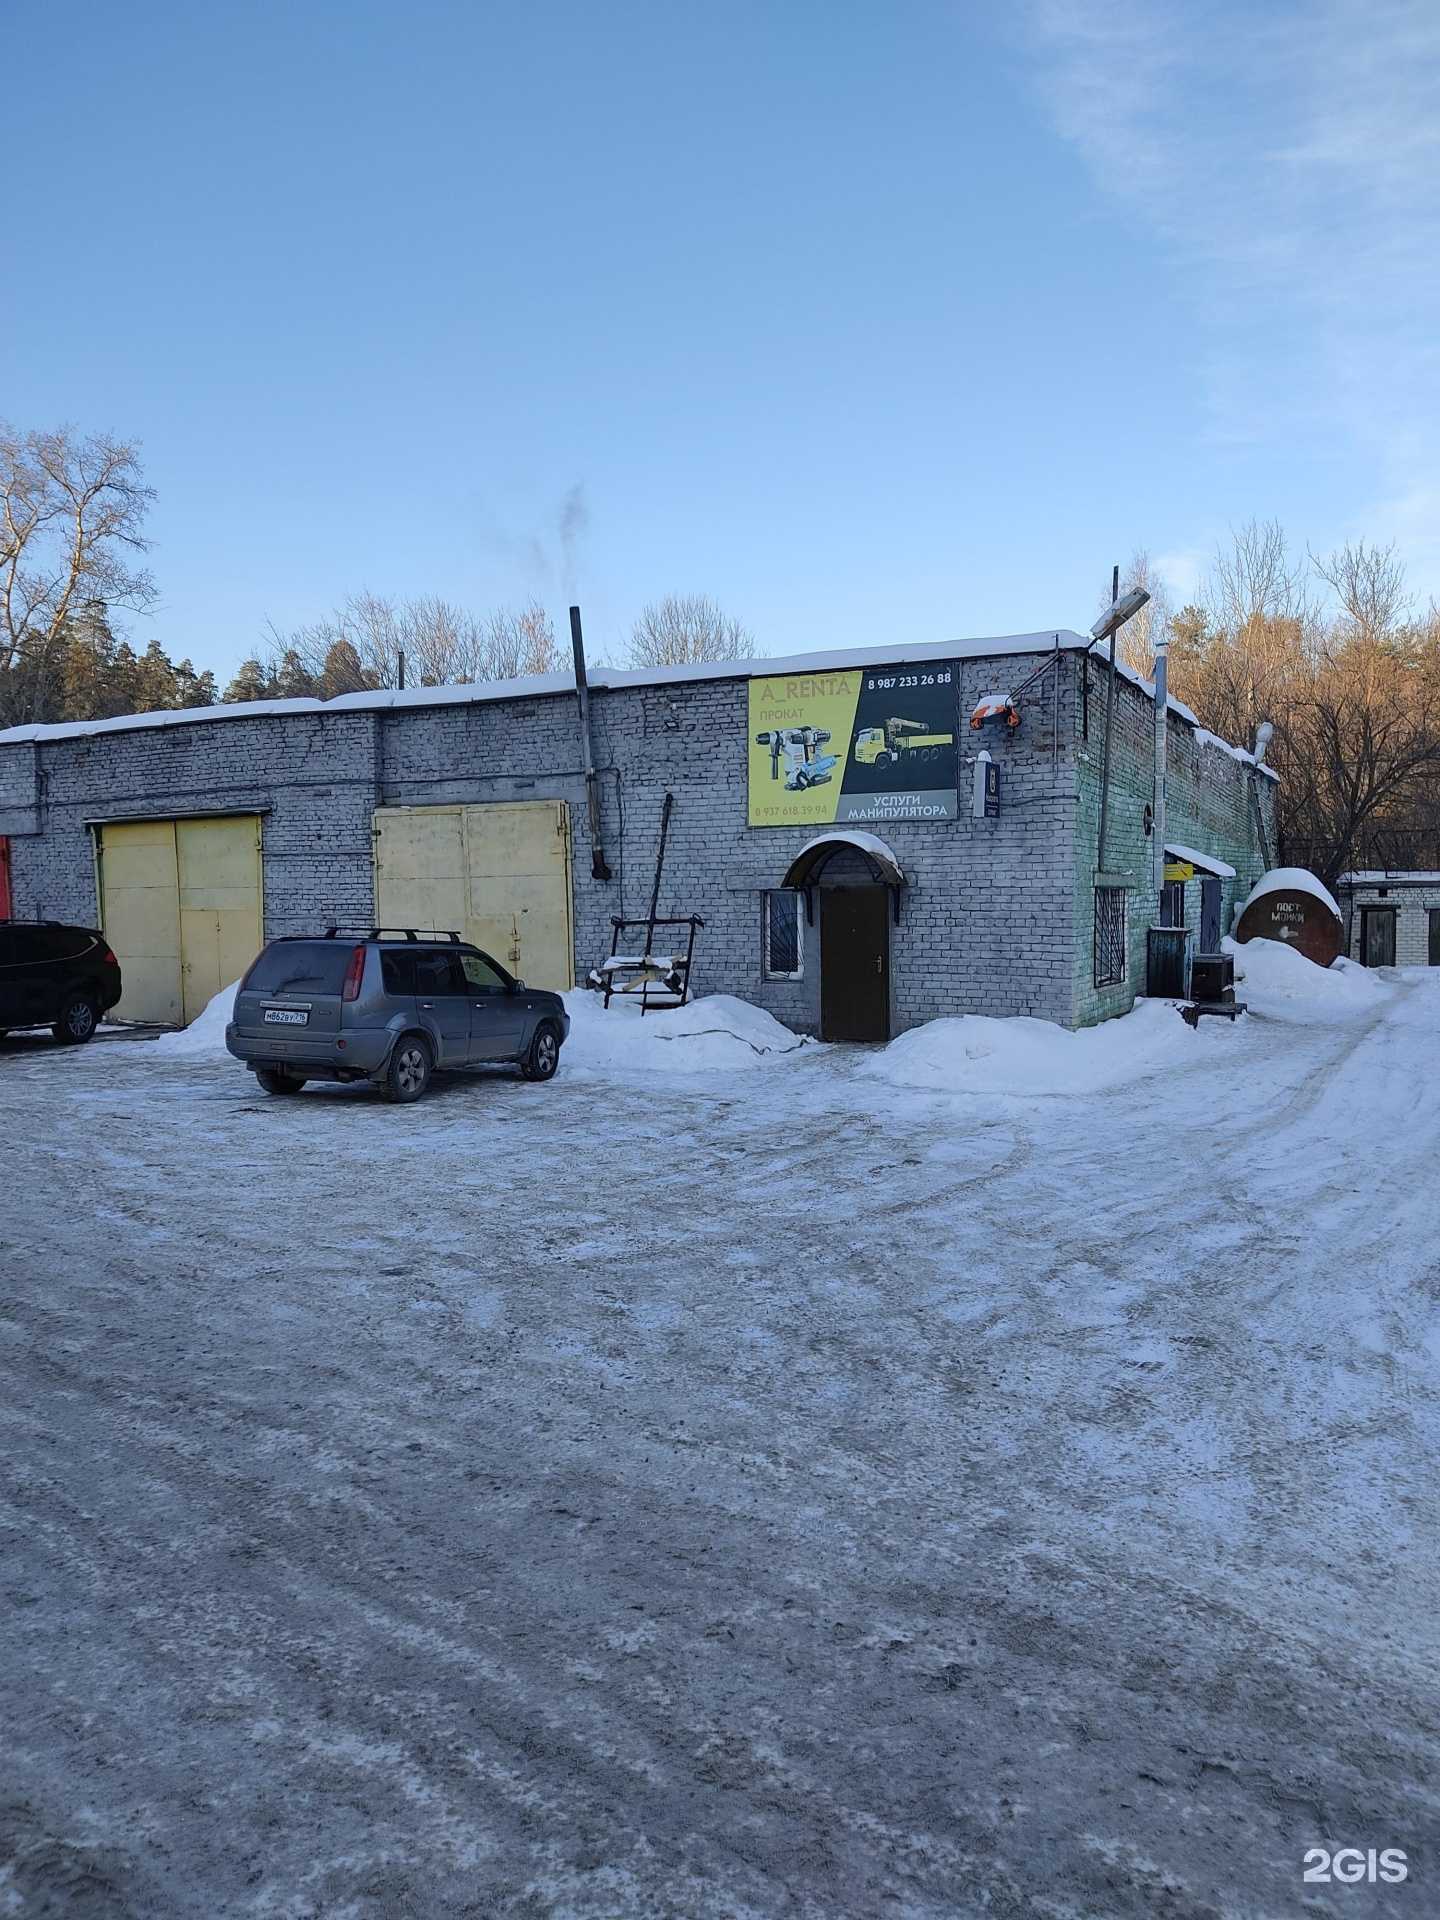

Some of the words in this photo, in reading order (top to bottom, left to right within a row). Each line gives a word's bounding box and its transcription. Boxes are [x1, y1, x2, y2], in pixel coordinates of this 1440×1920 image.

[868, 680, 875, 690] 8
[877, 677, 896, 689] 987
[899, 675, 918, 687] 233
[920, 674, 934, 685] 26
[937, 673, 951, 684] 88
[760, 678, 850, 703] A_RENTA
[760, 708, 805, 721] ПРОКАТ
[873, 795, 921, 807] УСЛУГИ
[763, 807, 780, 817] 937
[782, 806, 799, 816] 618
[848, 805, 948, 819] МАНИПУЛЯТОРА
